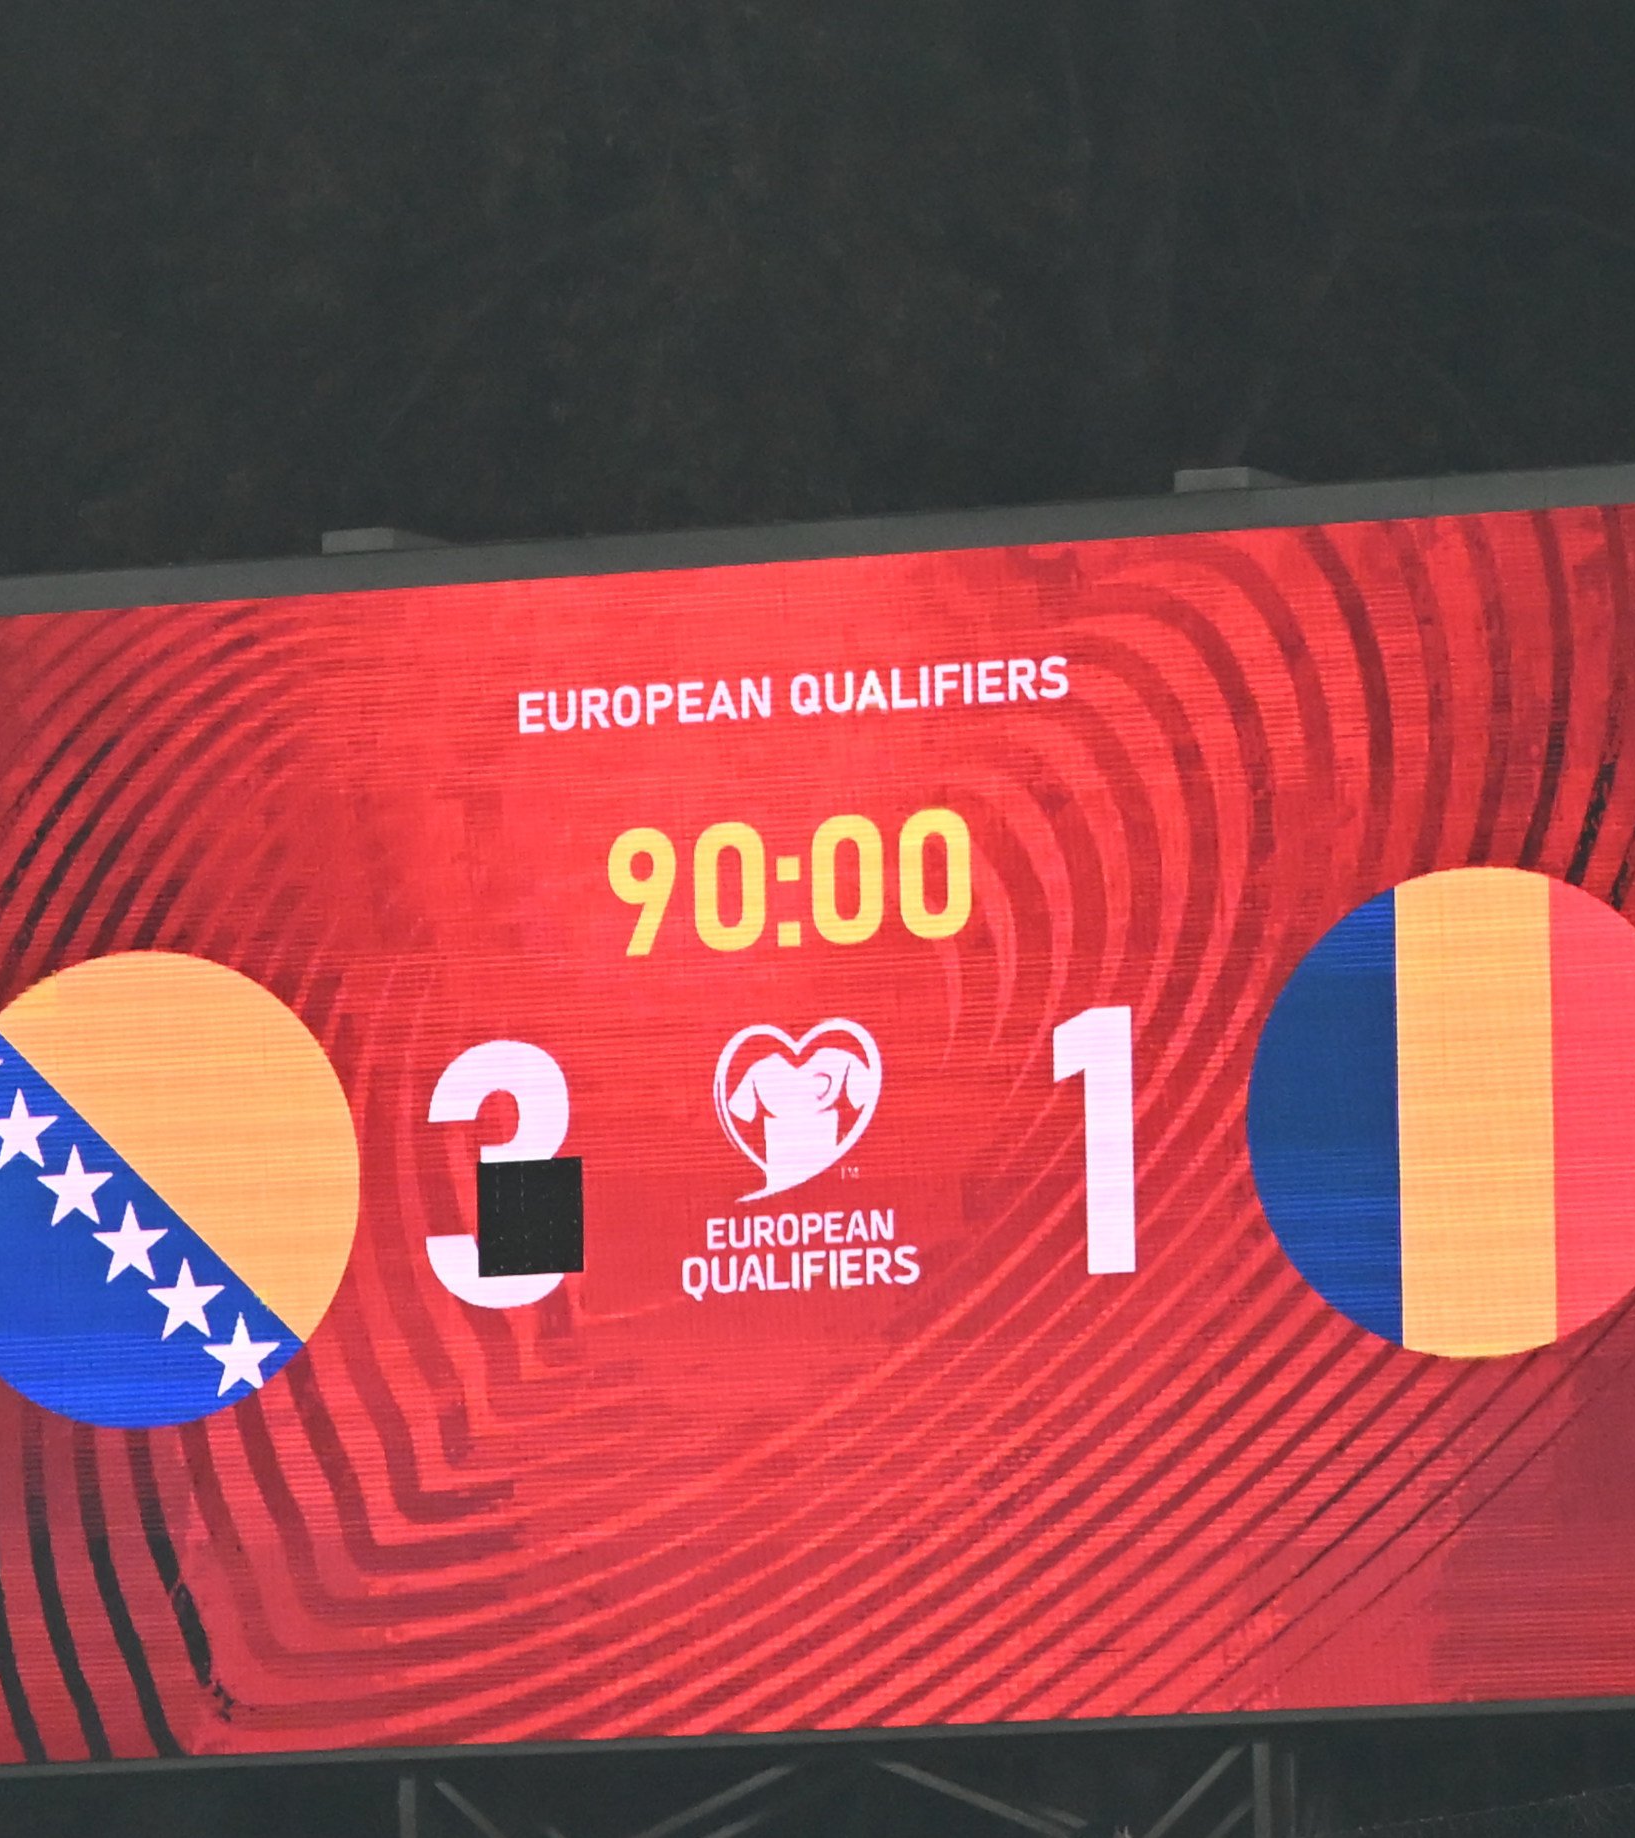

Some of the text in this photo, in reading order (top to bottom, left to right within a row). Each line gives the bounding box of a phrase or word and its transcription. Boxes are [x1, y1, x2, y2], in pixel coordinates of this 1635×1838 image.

[518, 656, 1070, 733] EUROPEAN QUALIFIERS
[607, 808, 972, 957] 90:00
[426, 1040, 569, 1309] 3
[1052, 1005, 1136, 1275] 1
[681, 1245, 921, 1303] QUALIFIERS
[706, 1208, 895, 1250] EUROPEAN
